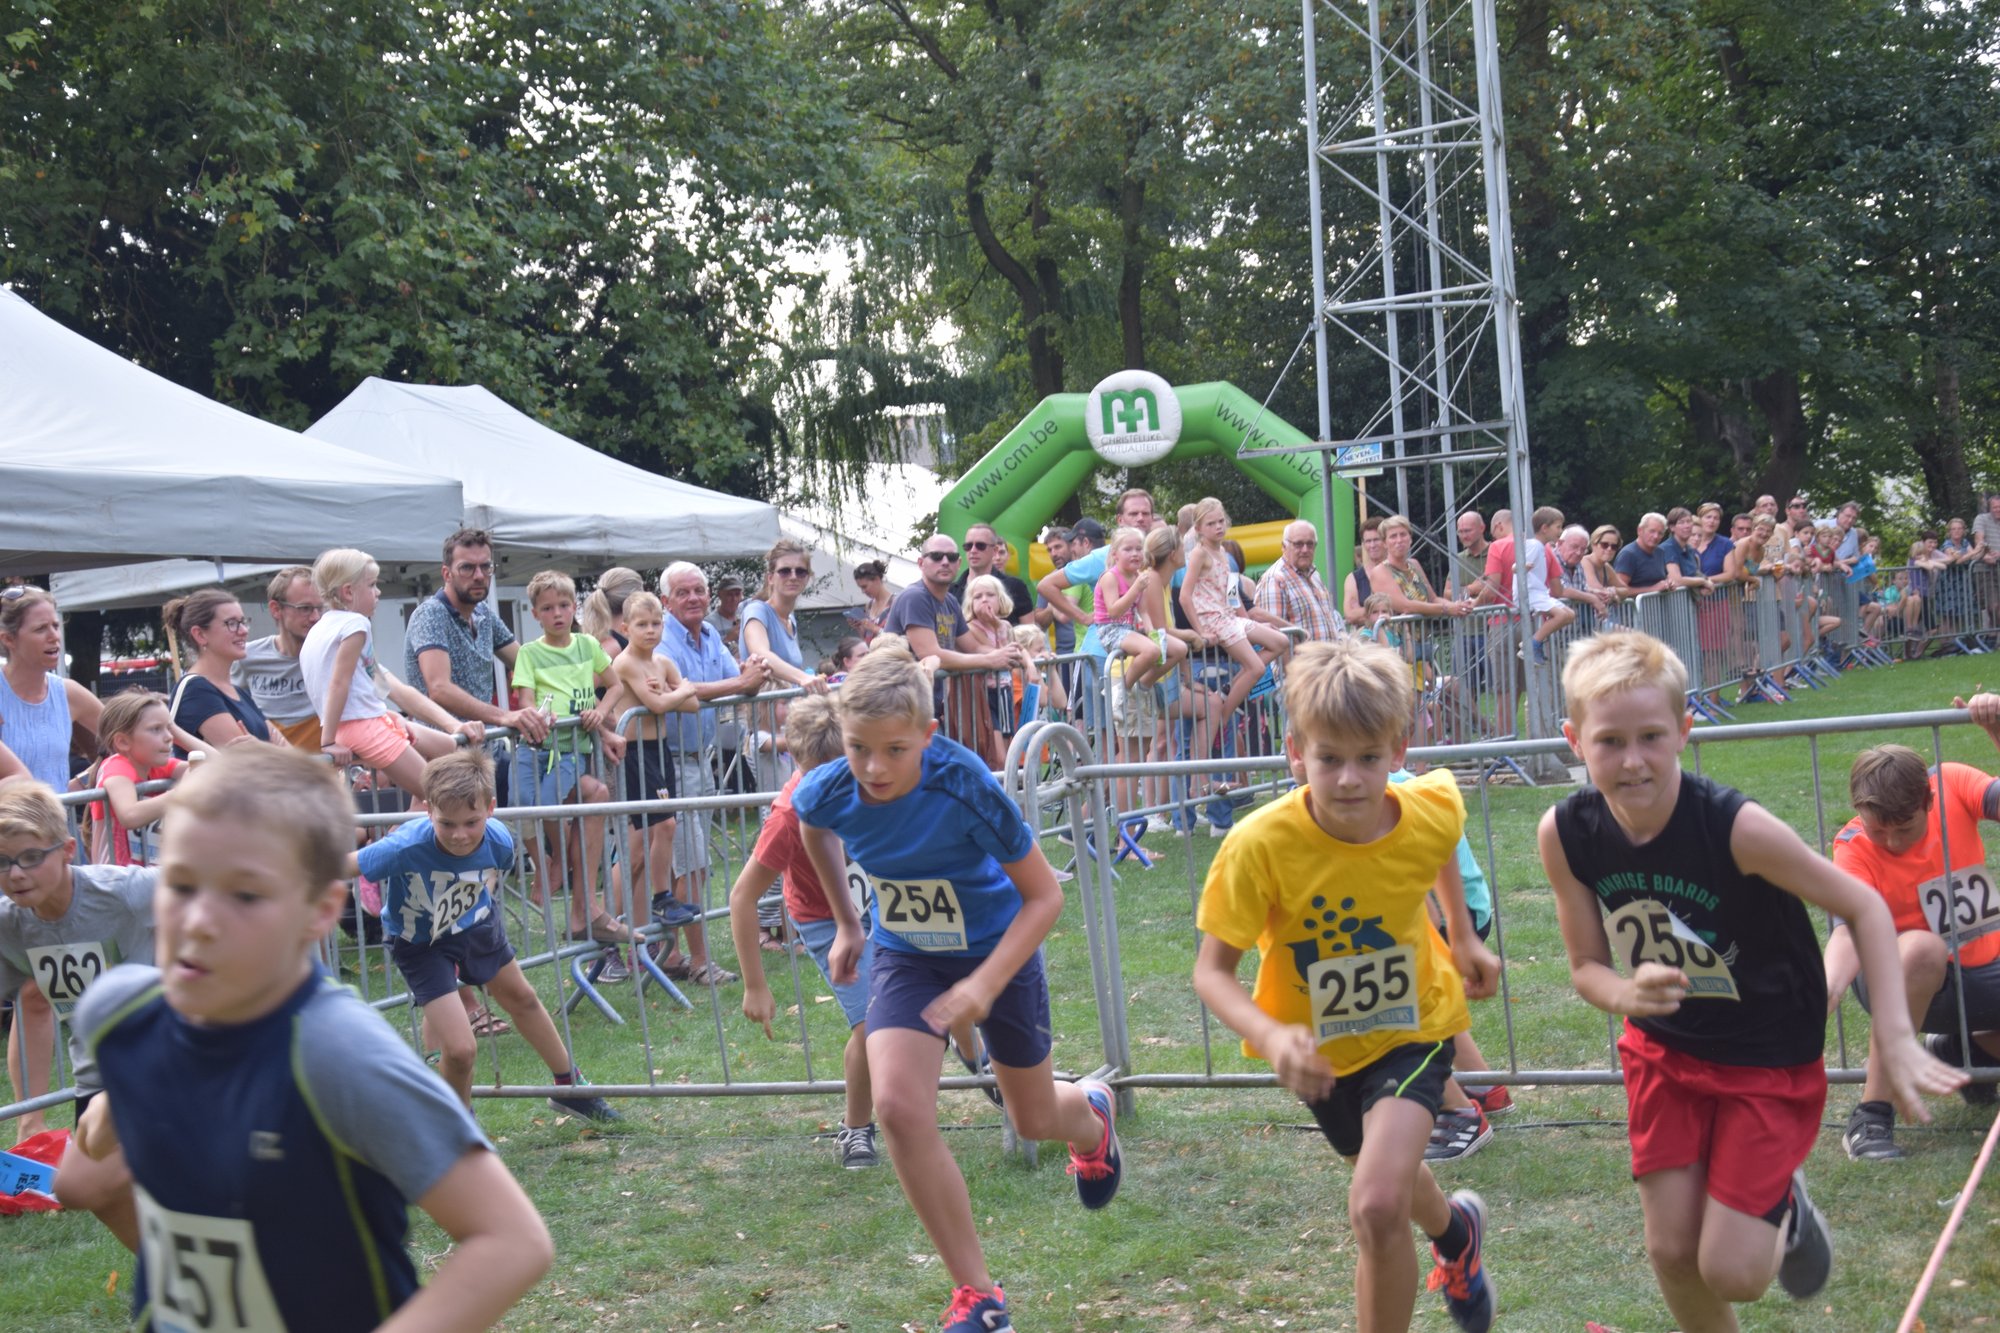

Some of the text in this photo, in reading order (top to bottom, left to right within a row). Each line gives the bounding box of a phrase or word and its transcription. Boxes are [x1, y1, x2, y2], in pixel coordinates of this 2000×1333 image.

[957, 420, 1058, 510] www.cm.be
[1102, 443, 1159, 455] MUTUALITEIT
[438, 883, 476, 932] 253
[880, 882, 956, 923] 254
[1595, 872, 1720, 911] UNRISE BOARDS
[1926, 874, 2000, 934] 252
[1319, 954, 1409, 1018] 255
